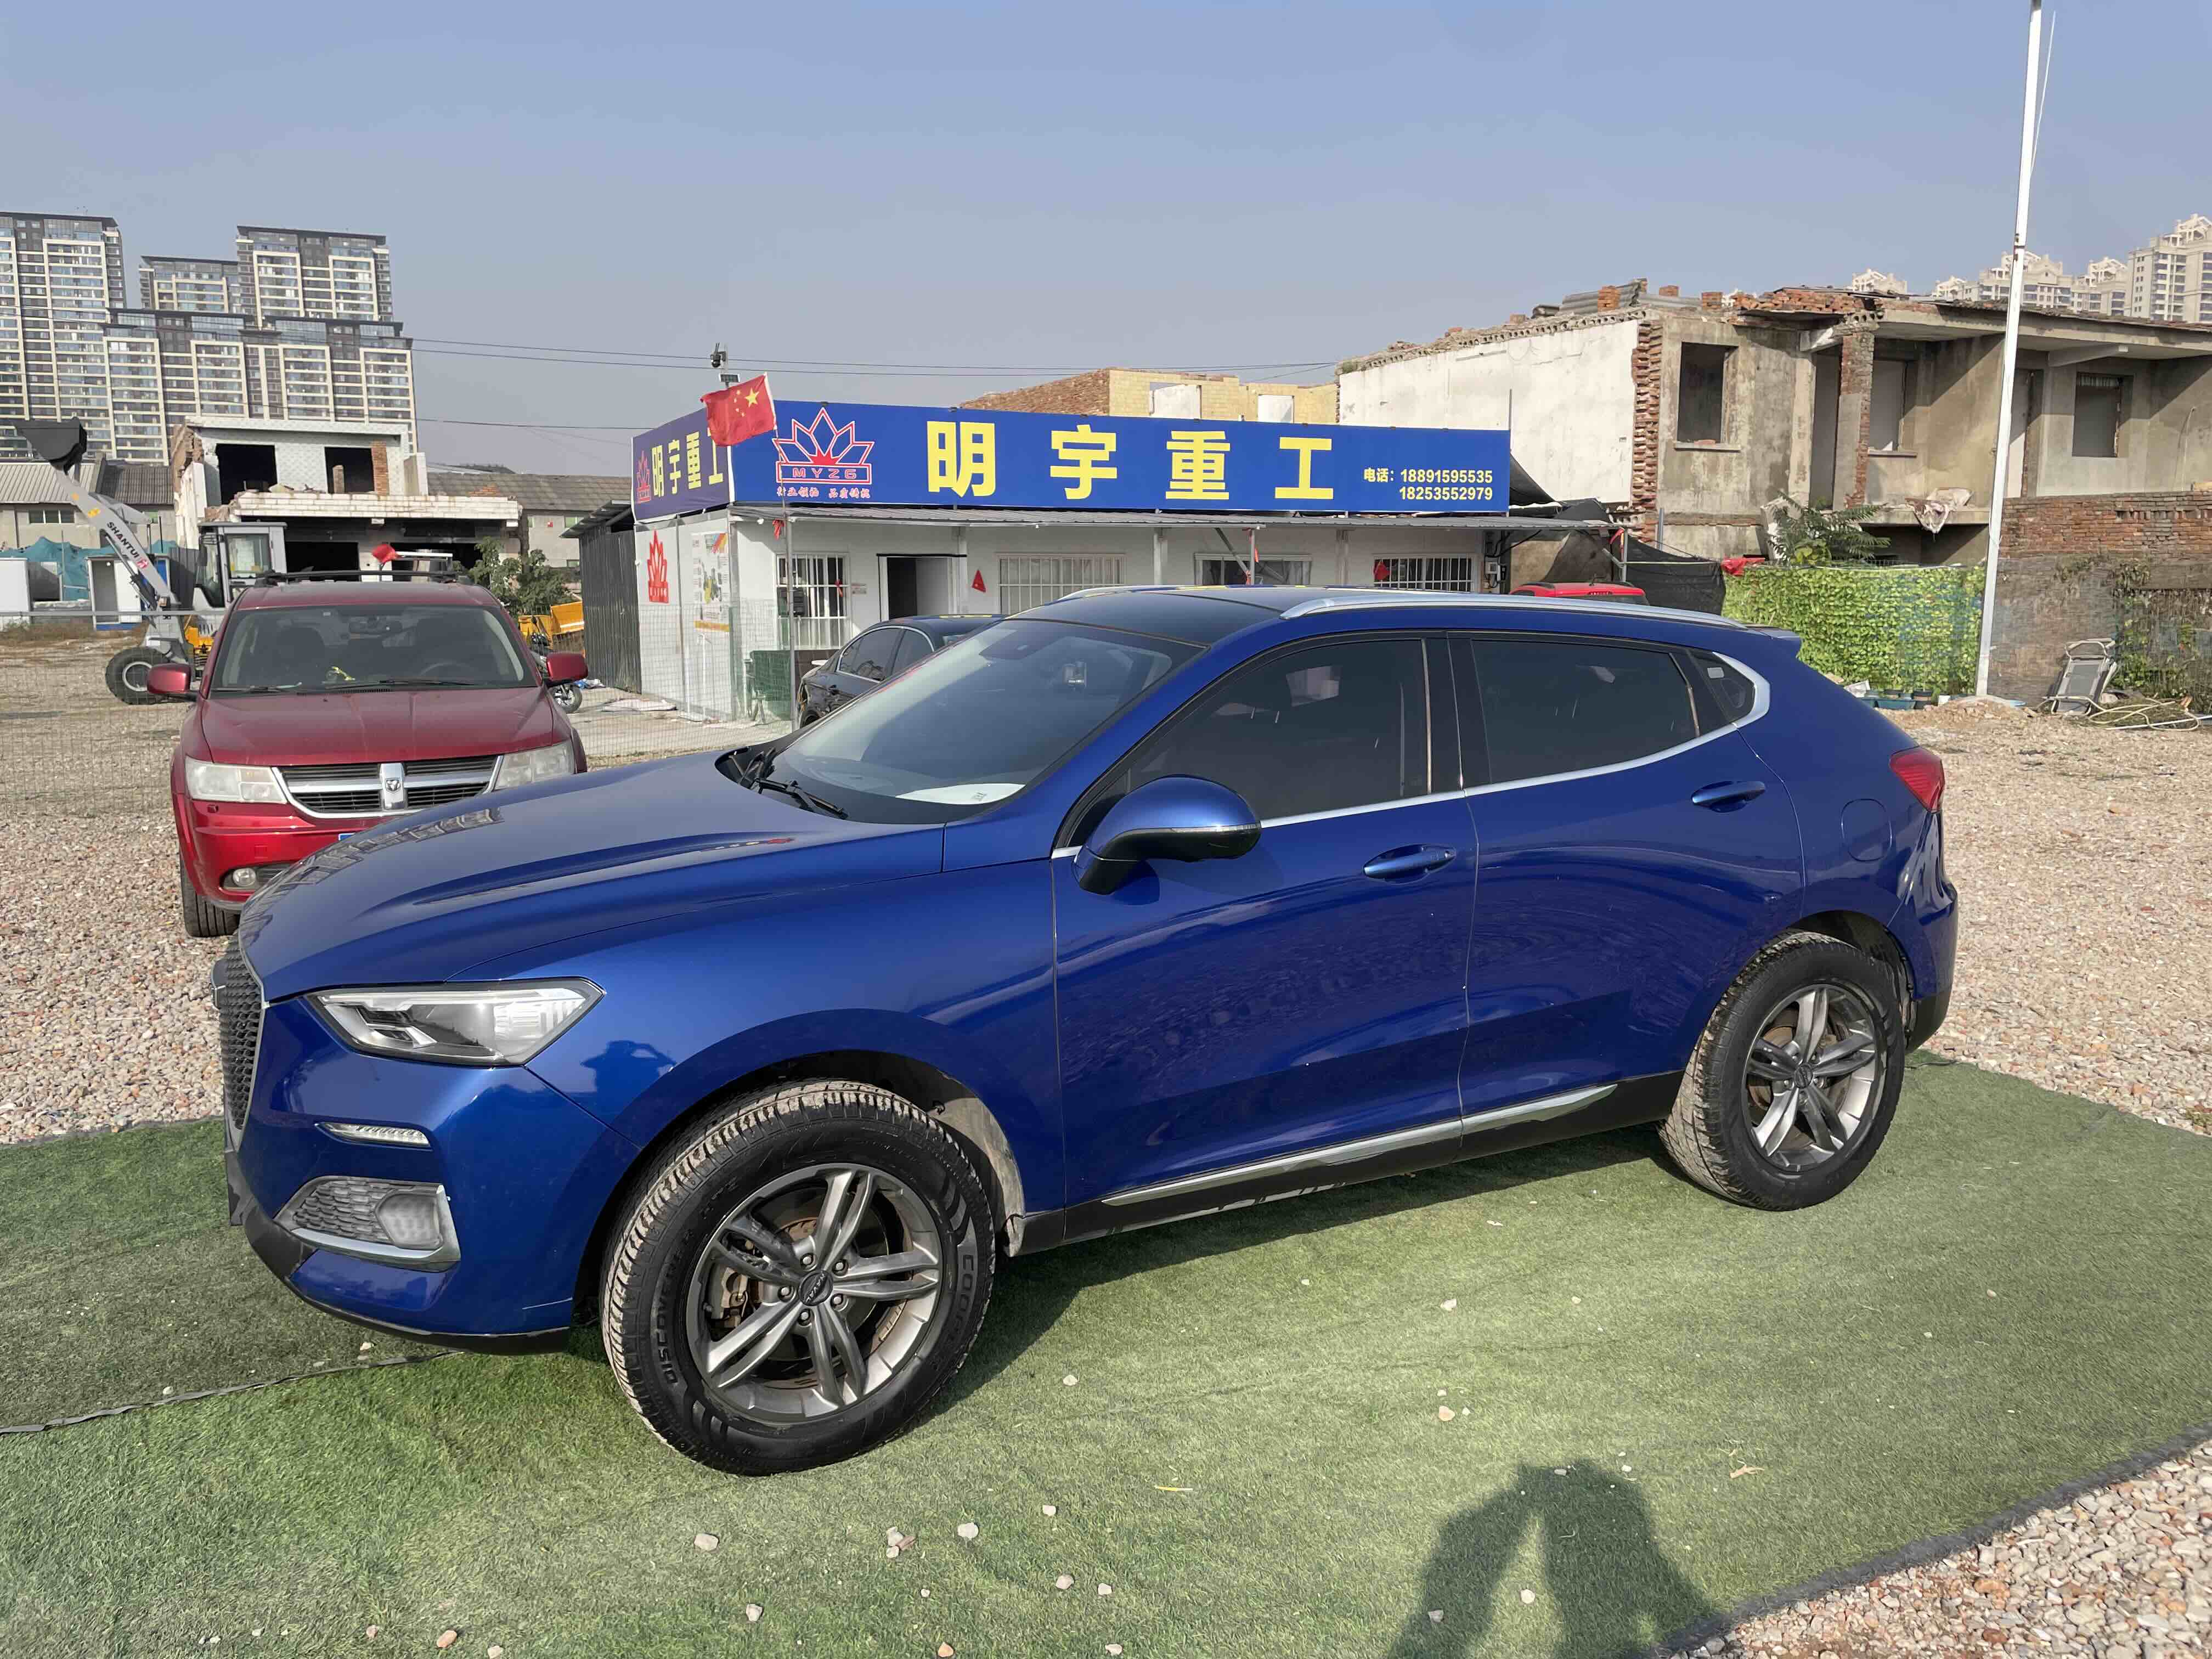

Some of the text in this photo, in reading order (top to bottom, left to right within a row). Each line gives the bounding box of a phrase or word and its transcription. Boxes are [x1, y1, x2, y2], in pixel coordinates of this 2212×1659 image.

[651, 427, 723, 497] 明宇重工
[792, 467, 857, 479] MYZG
[926, 421, 1334, 500] 明宇重工
[1399, 486, 1493, 500] 18253552979
[107, 522, 140, 558] SHANTUI
[805, 1273, 826, 1304] HAVAL
